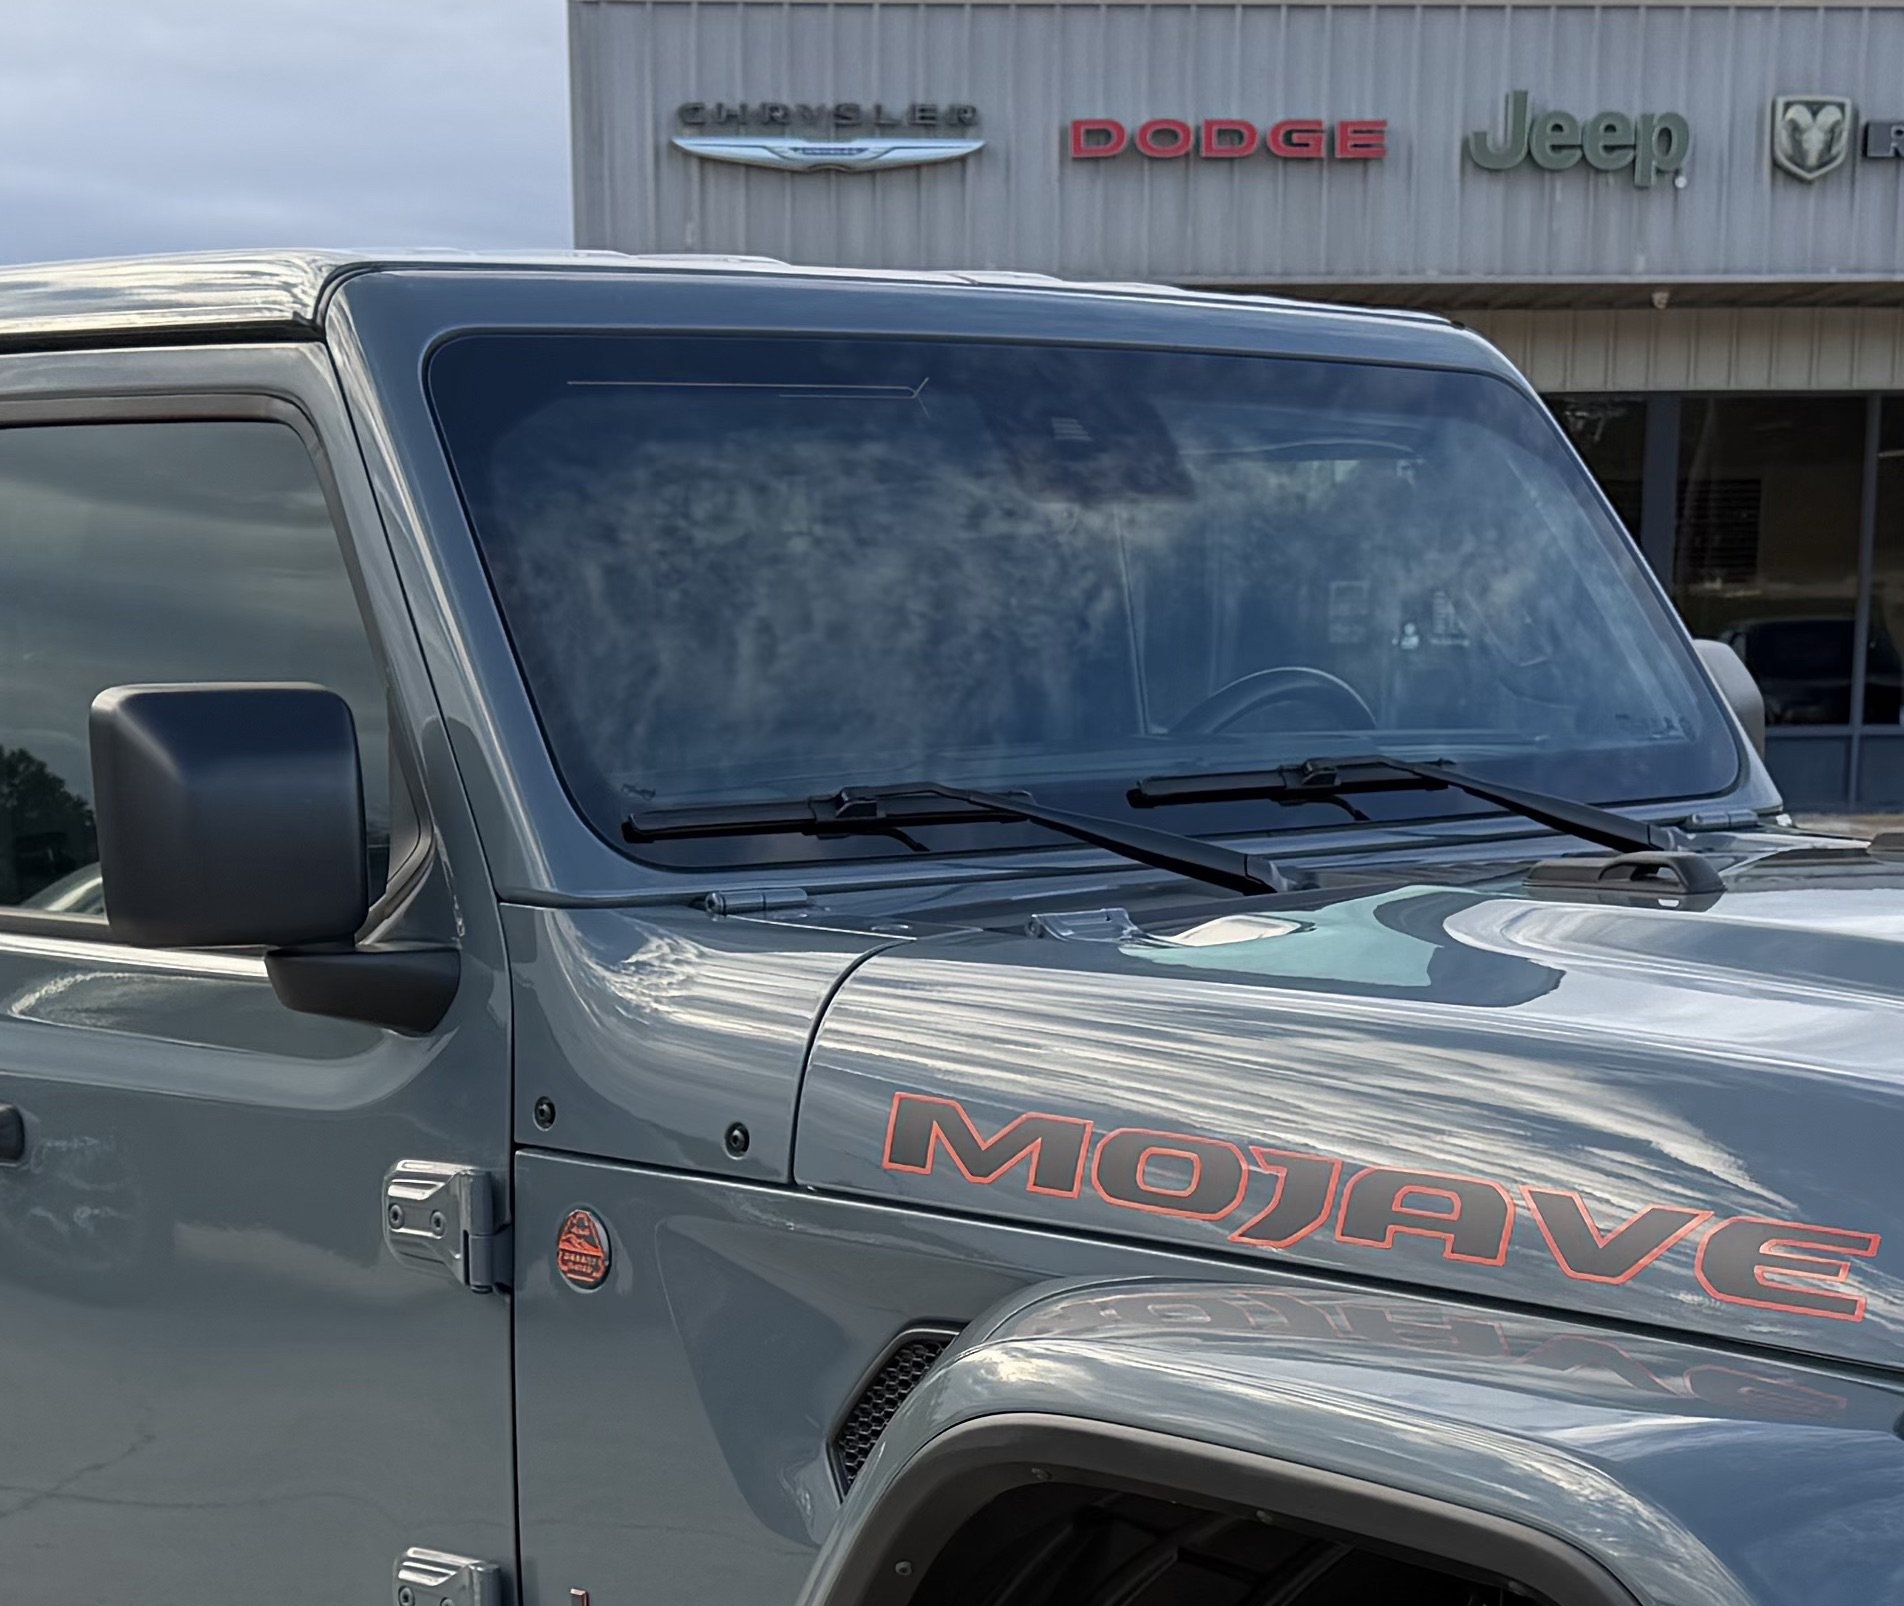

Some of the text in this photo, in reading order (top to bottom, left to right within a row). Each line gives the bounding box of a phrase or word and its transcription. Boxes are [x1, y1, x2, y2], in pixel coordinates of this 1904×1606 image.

[678, 102, 979, 128] CHRYSLER
[1069, 118, 1388, 160] DODGE
[1469, 90, 1691, 190] Jeep
[883, 1092, 1881, 1322] MOJAVE
